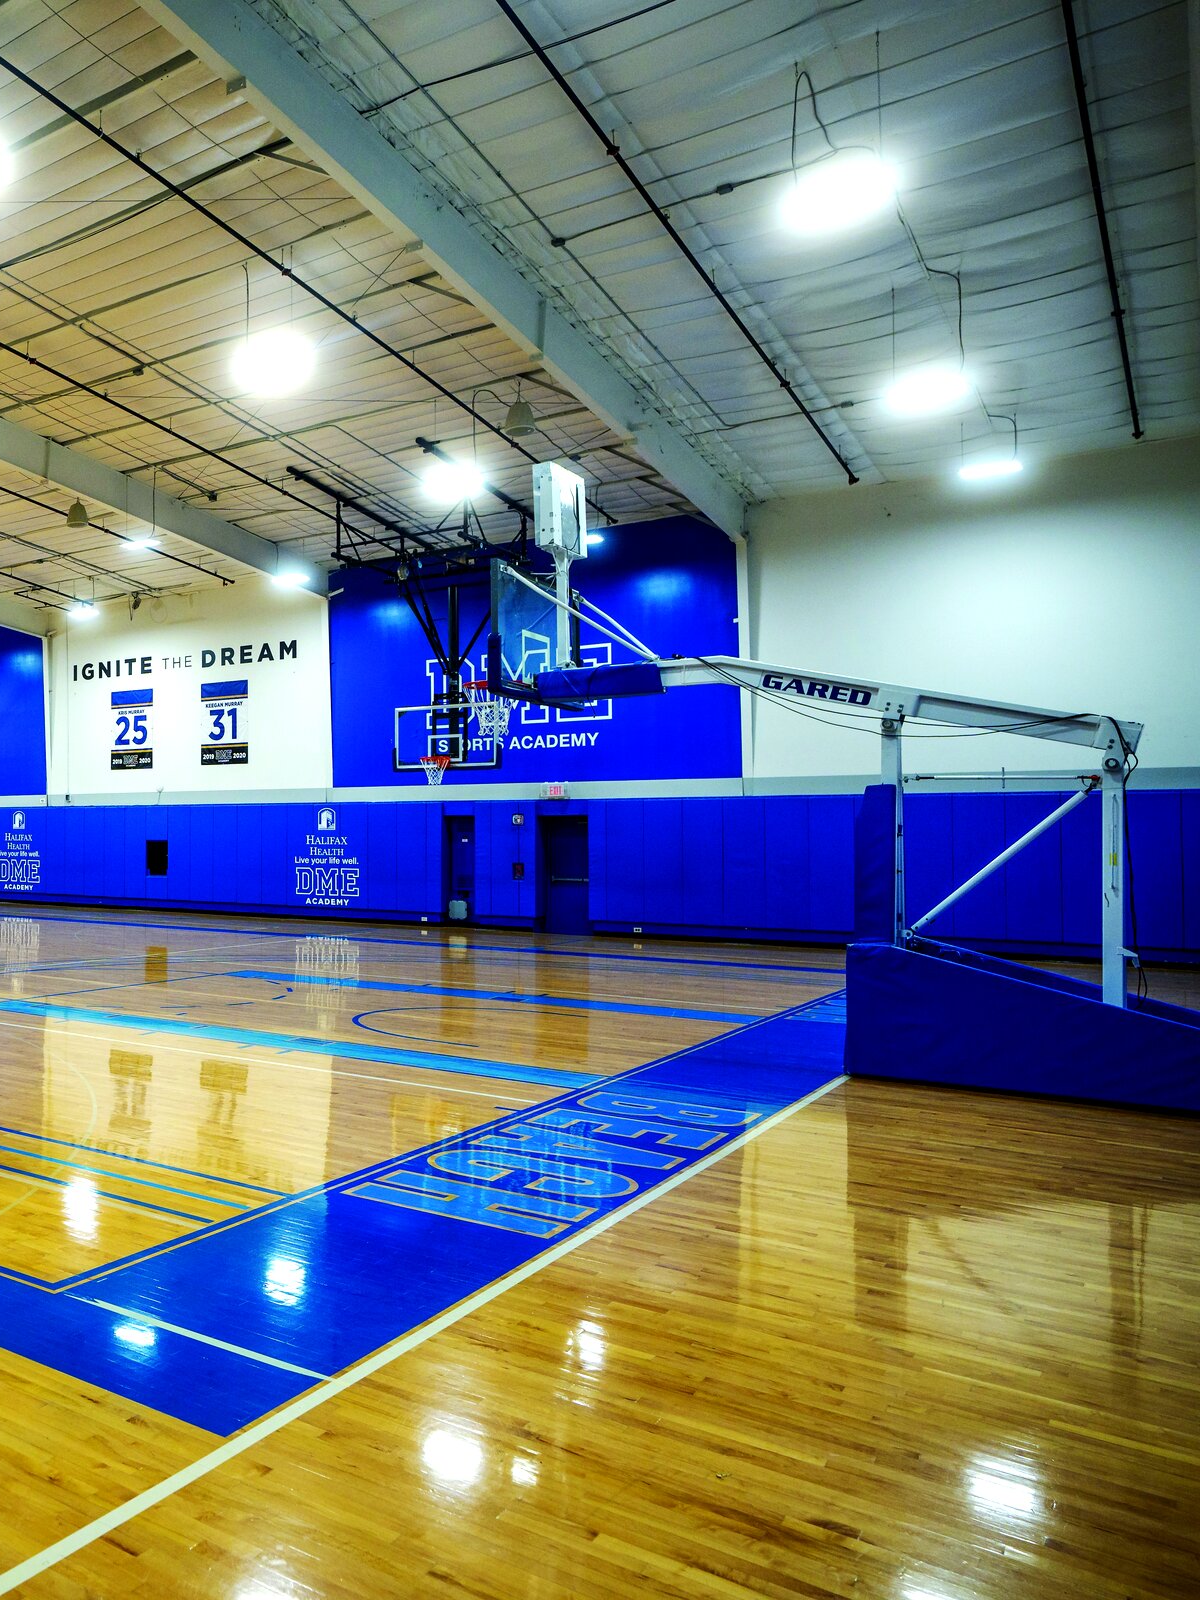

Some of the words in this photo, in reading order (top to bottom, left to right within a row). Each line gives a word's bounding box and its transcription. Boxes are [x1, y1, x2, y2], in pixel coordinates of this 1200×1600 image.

[73, 656, 153, 682] IGNITE
[162, 655, 192, 670] THE
[201, 639, 298, 668] DREAM
[762, 674, 872, 706] GARED
[115, 715, 148, 746] 25
[208, 707, 238, 741] 31
[438, 735, 504, 753] SORTS
[509, 732, 600, 751] ACADEMY
[5, 833, 32, 841] HALIFAX
[306, 835, 348, 845] HALIFAX
[7, 842, 30, 850] HEALTH
[309, 847, 344, 856] HEALTH
[294, 856, 309, 864] Live
[311, 857, 327, 865] your
[342, 857, 359, 865] well.
[4, 883, 34, 891] ACADEMY
[295, 867, 360, 897] DME
[305, 897, 350, 906] ACADEMY
[340, 1091, 763, 1239] BEACH
